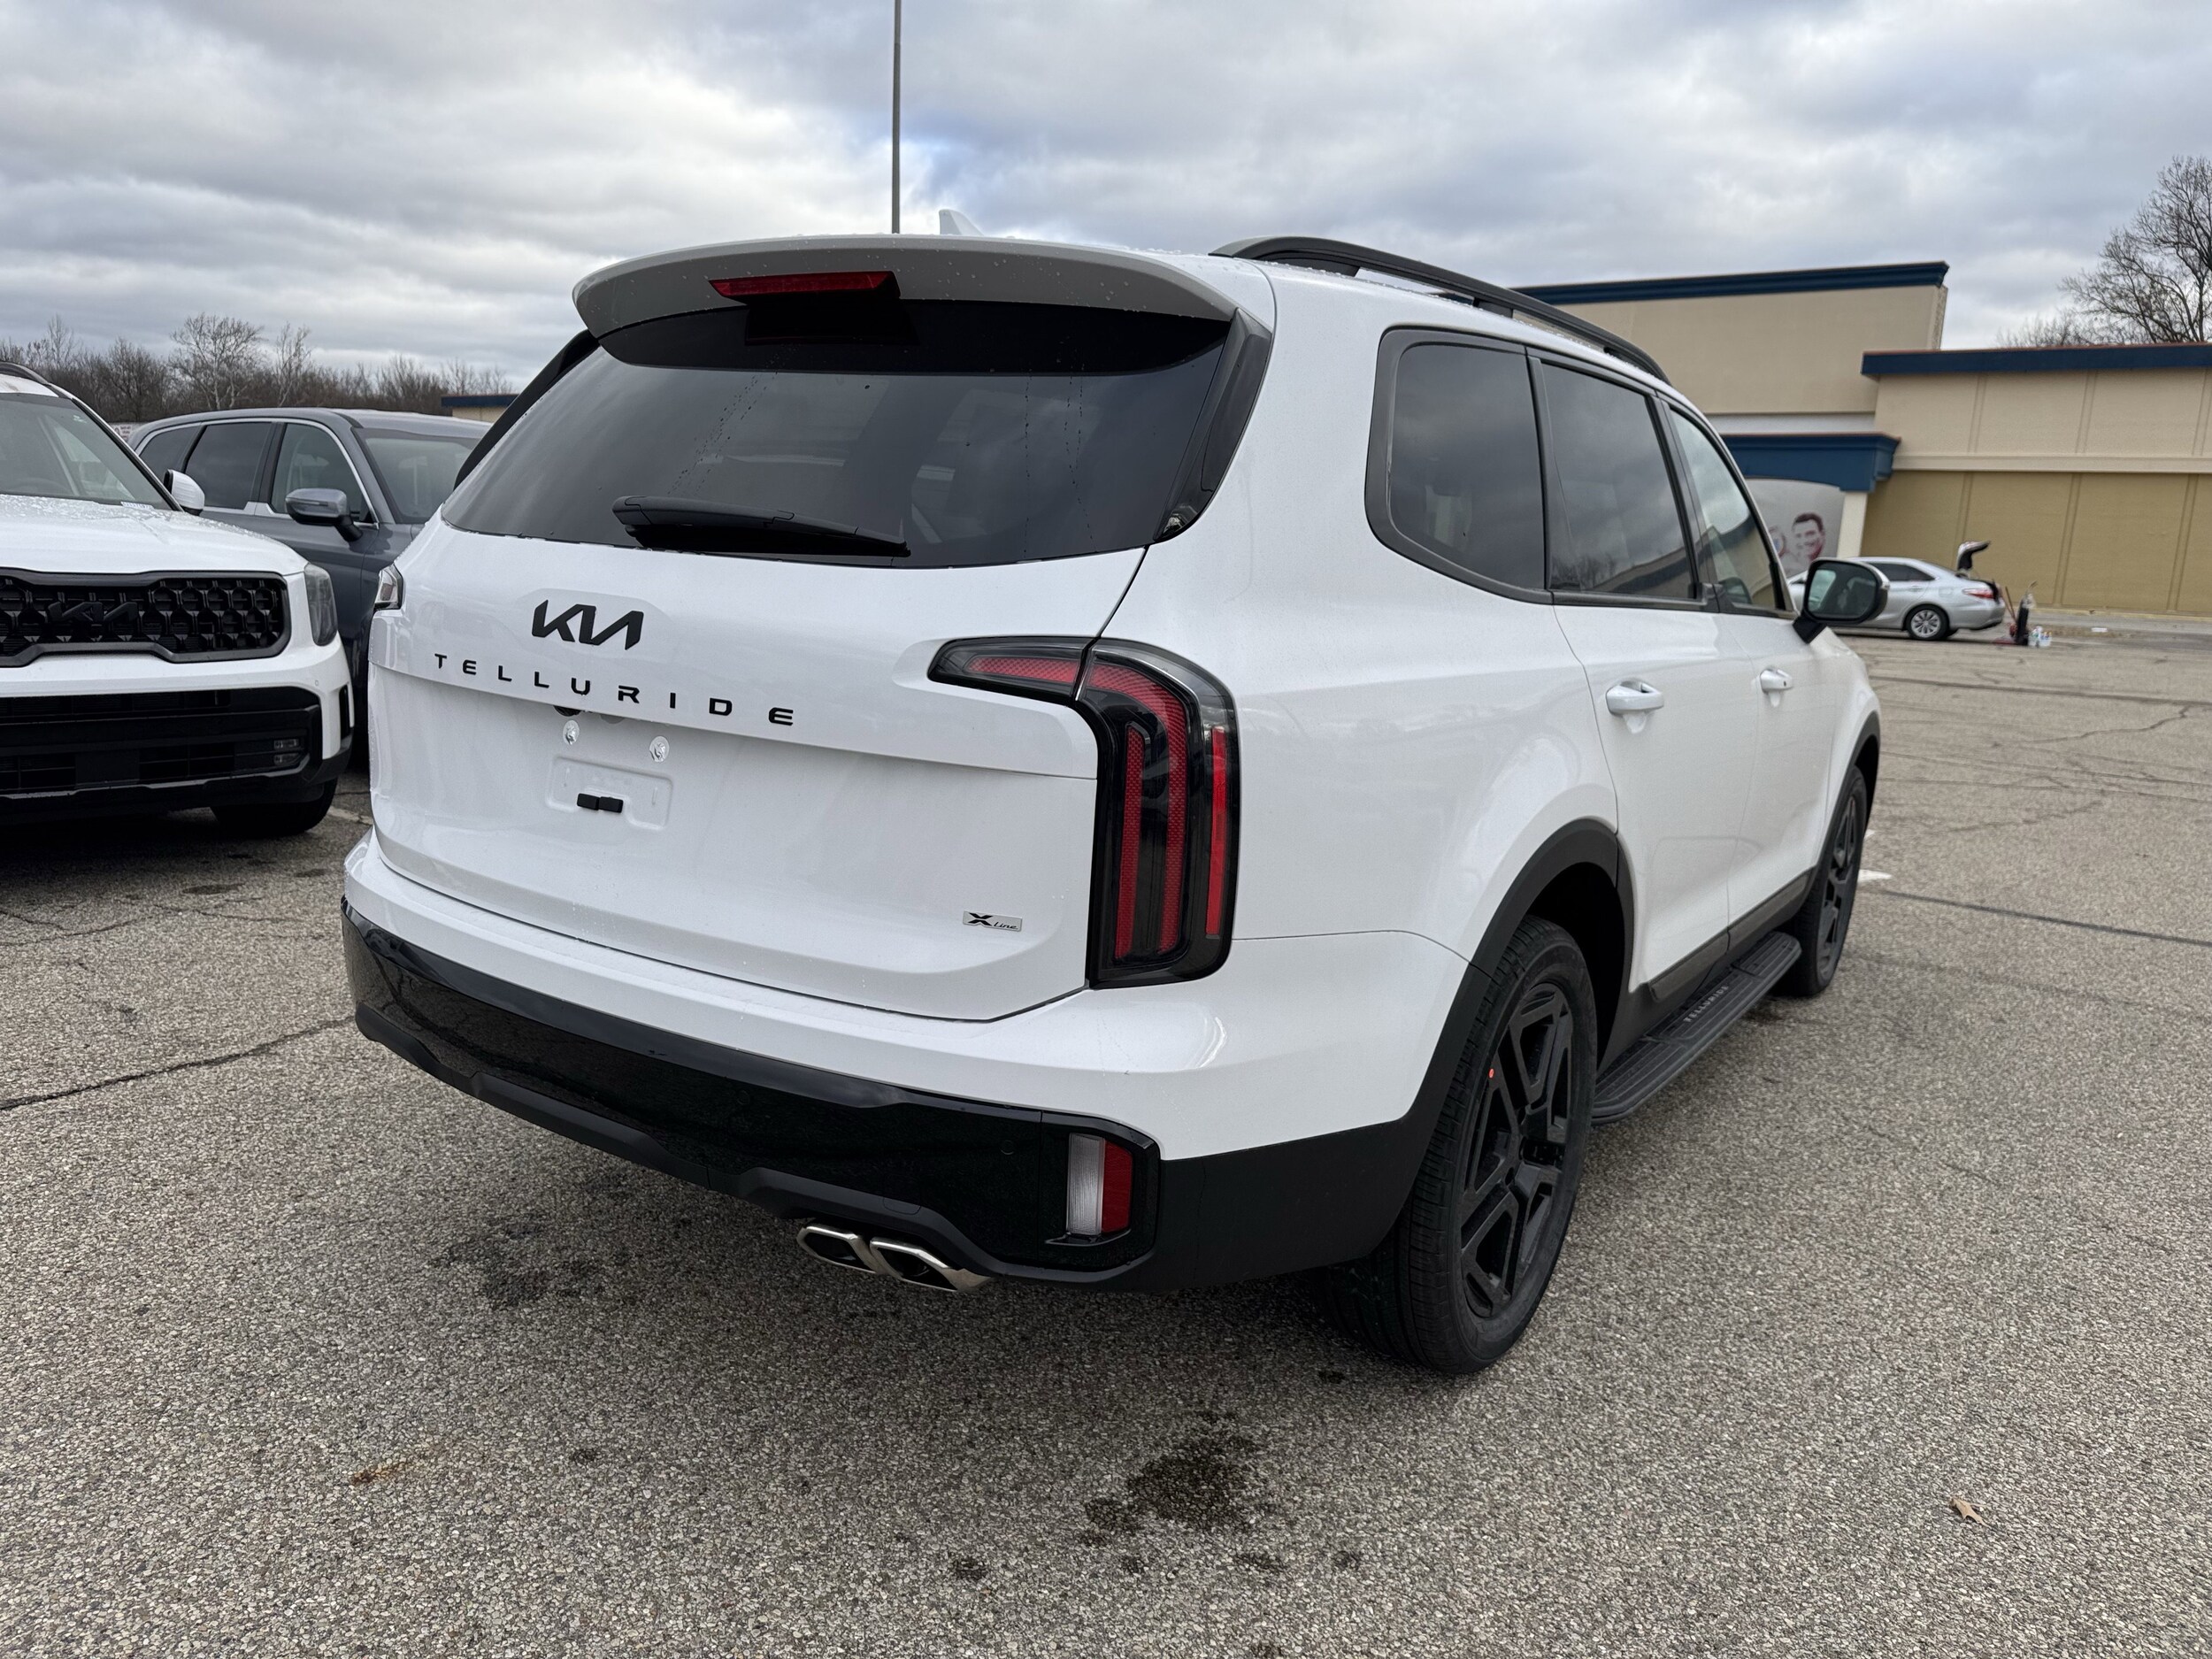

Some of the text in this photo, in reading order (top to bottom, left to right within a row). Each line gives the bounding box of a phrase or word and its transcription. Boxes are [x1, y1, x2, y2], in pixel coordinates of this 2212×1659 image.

[531, 599, 644, 650] KIA
[434, 653, 794, 726] TELLURIDE
[994, 921, 1018, 930] Line
